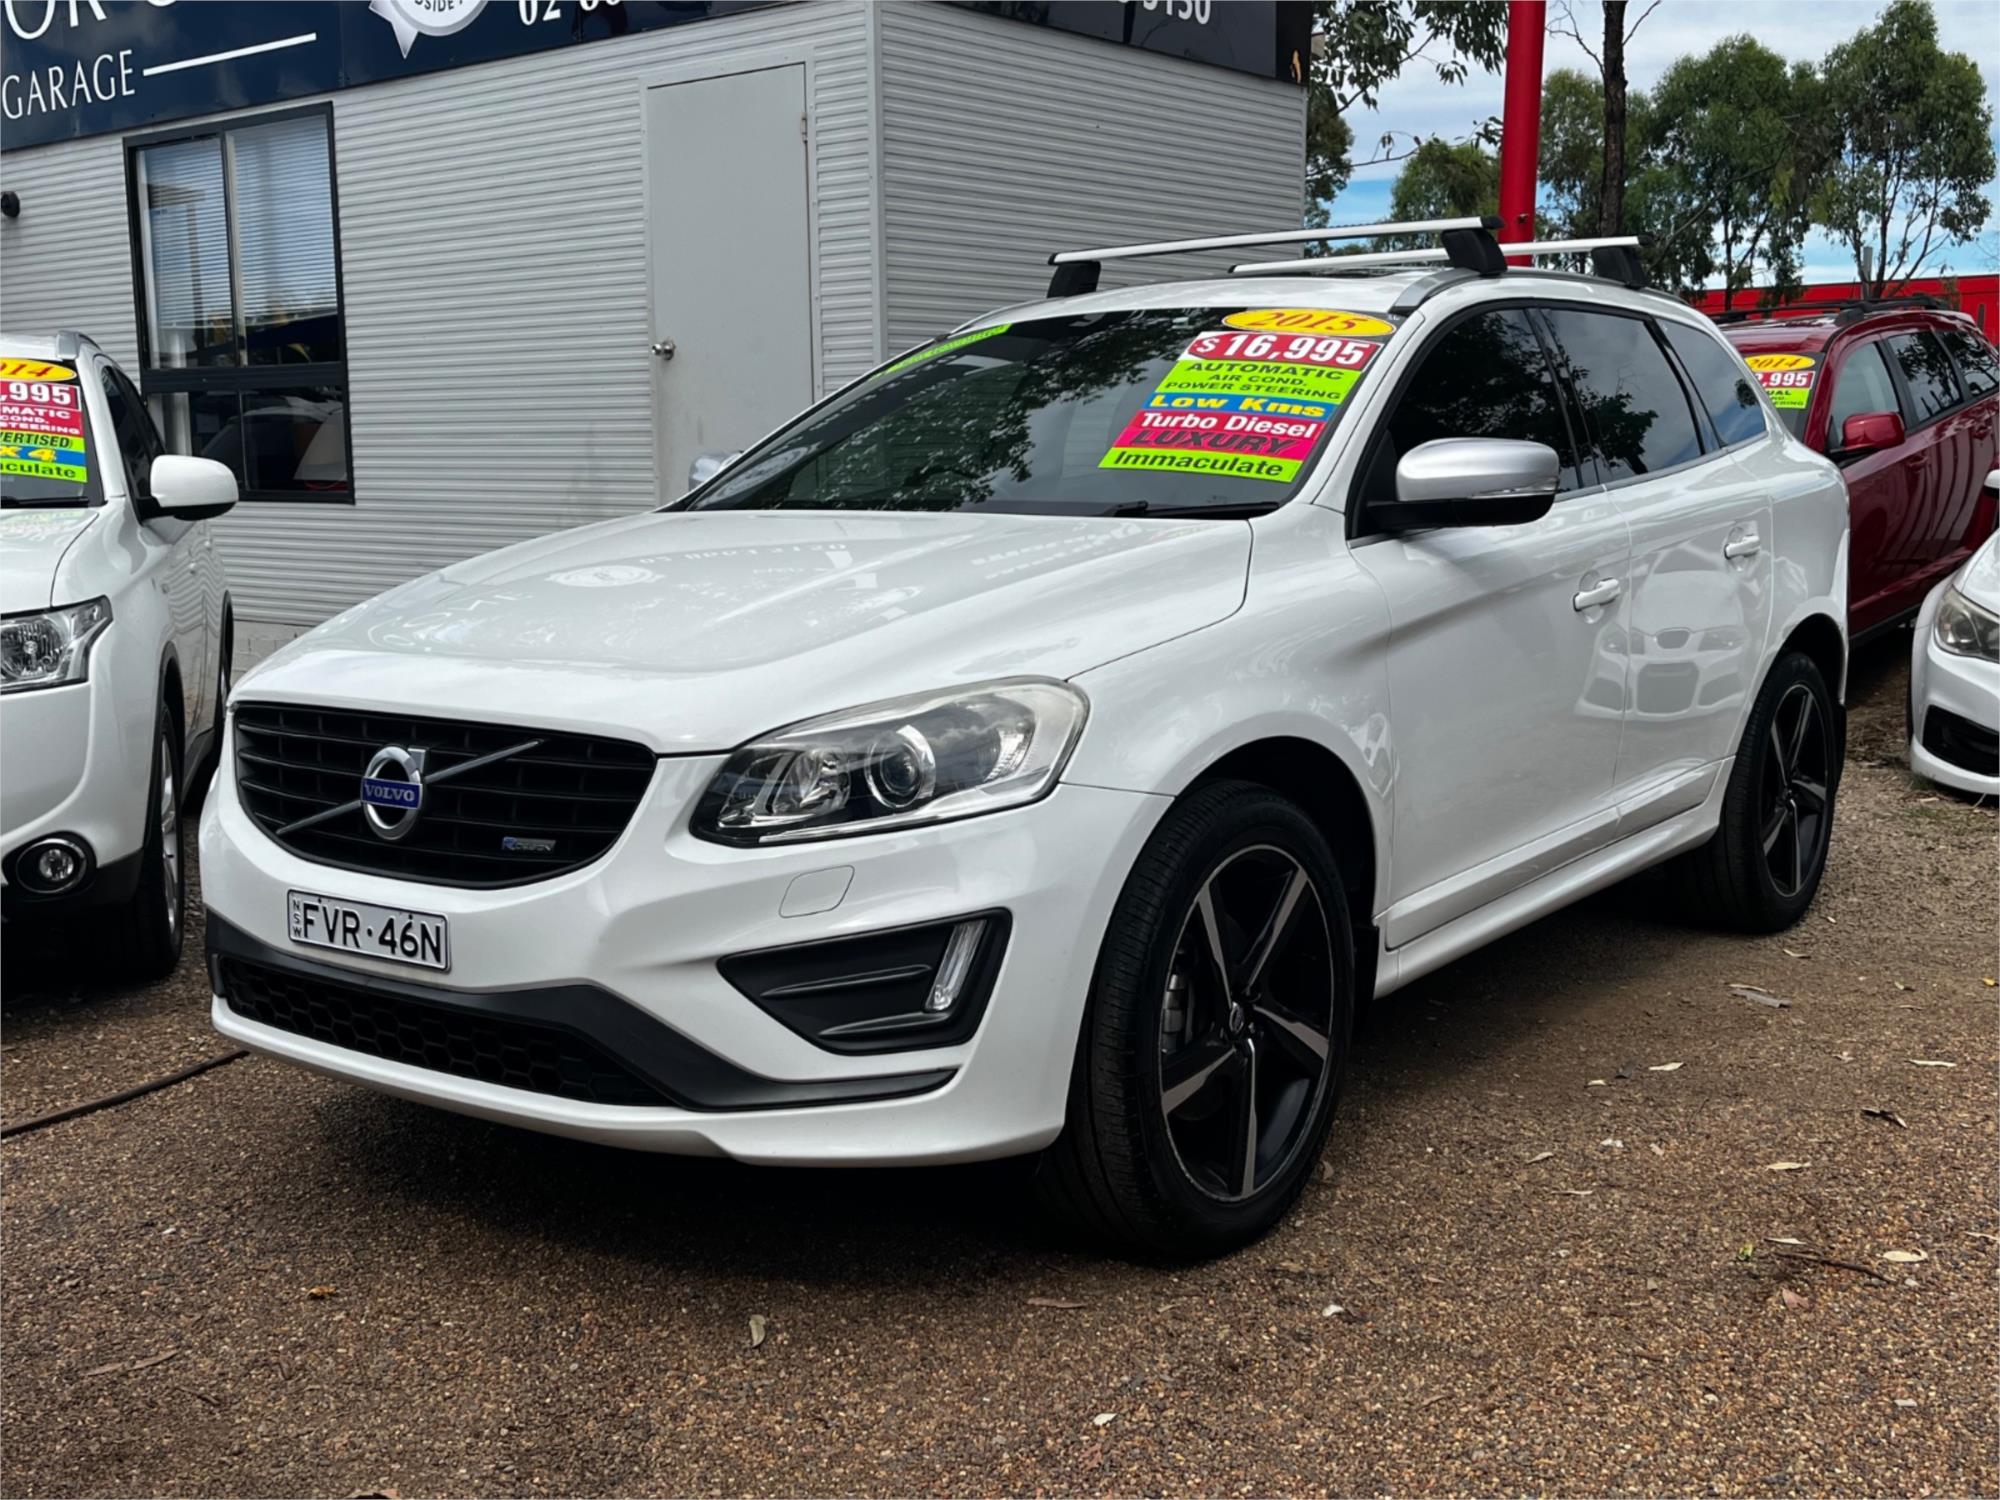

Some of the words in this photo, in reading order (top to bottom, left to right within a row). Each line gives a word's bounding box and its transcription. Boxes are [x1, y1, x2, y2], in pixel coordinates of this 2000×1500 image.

[1, 49, 136, 120] GARAGE
[1250, 312, 1367, 332] 2015
[1187, 362, 1345, 382] AUTOMATIC
[1209, 373, 1242, 384] AIR
[1250, 374, 1309, 387] COND.
[1165, 381, 1236, 393] POWER
[1240, 383, 1341, 401] STEERING
[1150, 394, 1225, 410] Low
[1240, 394, 1328, 418] Kms
[1140, 412, 1219, 431] Turbo
[1225, 415, 1318, 439] Diesel
[1130, 430, 1300, 456] LUXURY
[27, 448, 57, 463] 4
[1114, 450, 1284, 477] Immaculate
[364, 783, 415, 802] VOLVO
